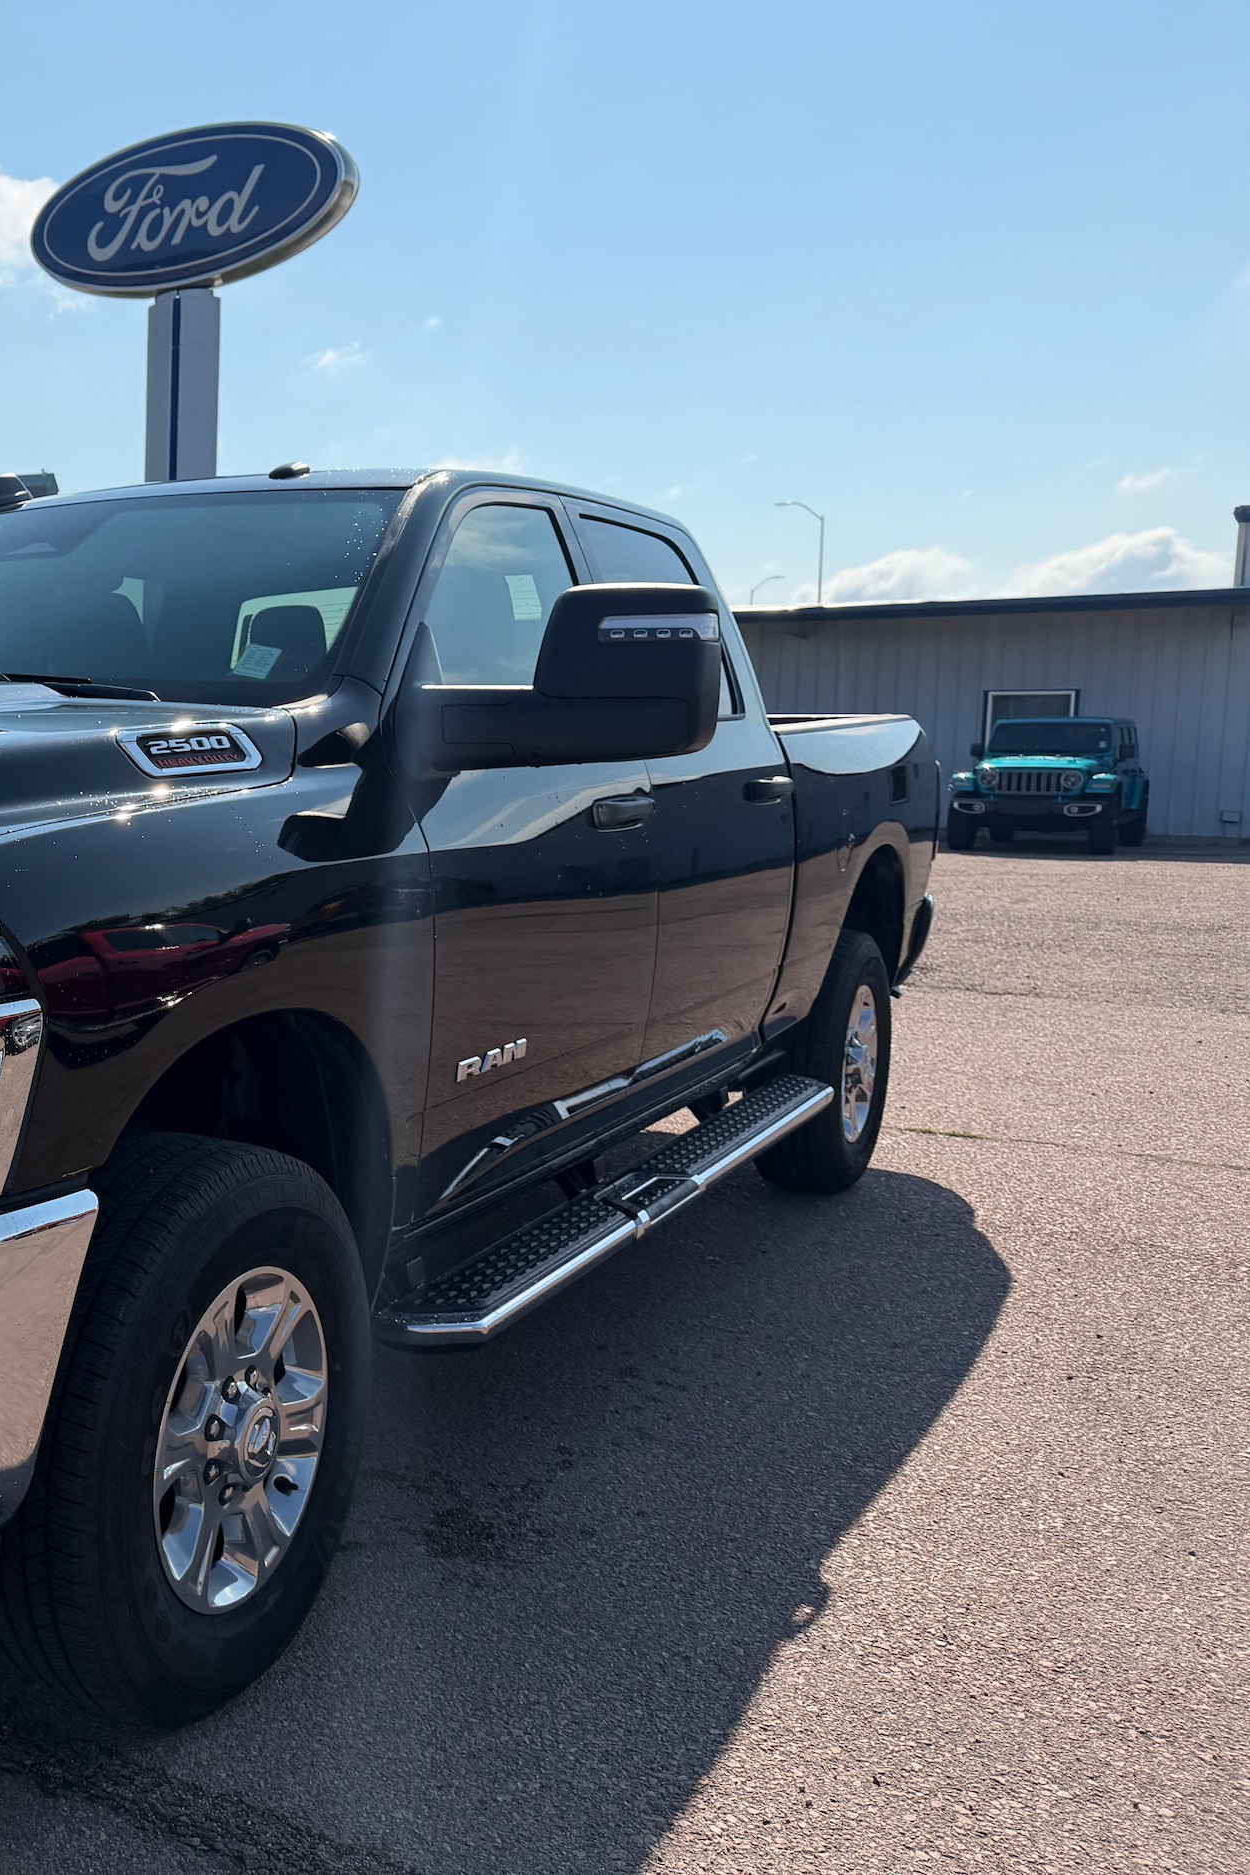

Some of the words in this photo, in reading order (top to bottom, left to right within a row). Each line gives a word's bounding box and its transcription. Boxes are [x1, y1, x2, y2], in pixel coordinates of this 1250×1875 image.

[87, 154, 265, 261] Ford
[146, 735, 231, 755] 2500
[157, 756, 203, 768] HEAVY
[204, 753, 239, 765] DUTY
[456, 1037, 528, 1083] RAM
